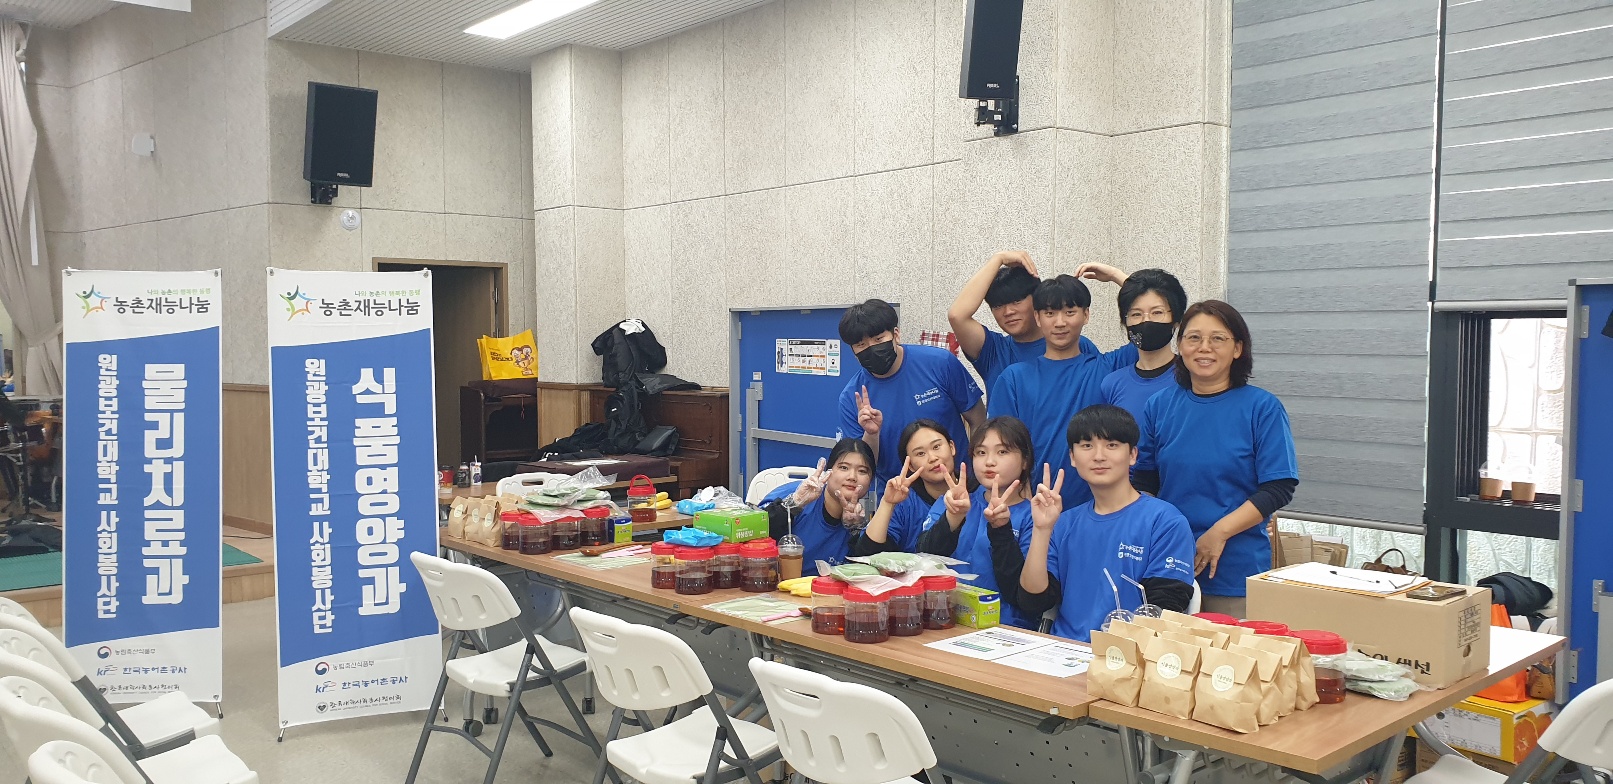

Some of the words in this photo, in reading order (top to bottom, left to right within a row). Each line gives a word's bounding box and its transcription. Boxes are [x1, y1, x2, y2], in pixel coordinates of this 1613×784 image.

[113, 296, 211, 315] 농촌재능나눔
[319, 298, 421, 317] 농촌재능나눔
[97, 353, 120, 505] 원광보건대학교
[141, 363, 190, 605] 물리치료과
[304, 358, 331, 516] 원광보건대학교
[351, 366, 407, 616] 식품영양과
[96, 510, 120, 619] 사회봉사단
[309, 521, 336, 634] 사회봉사단
[122, 665, 188, 675] 한국농어촌공사
[341, 675, 409, 690] 한국농어촌공사
